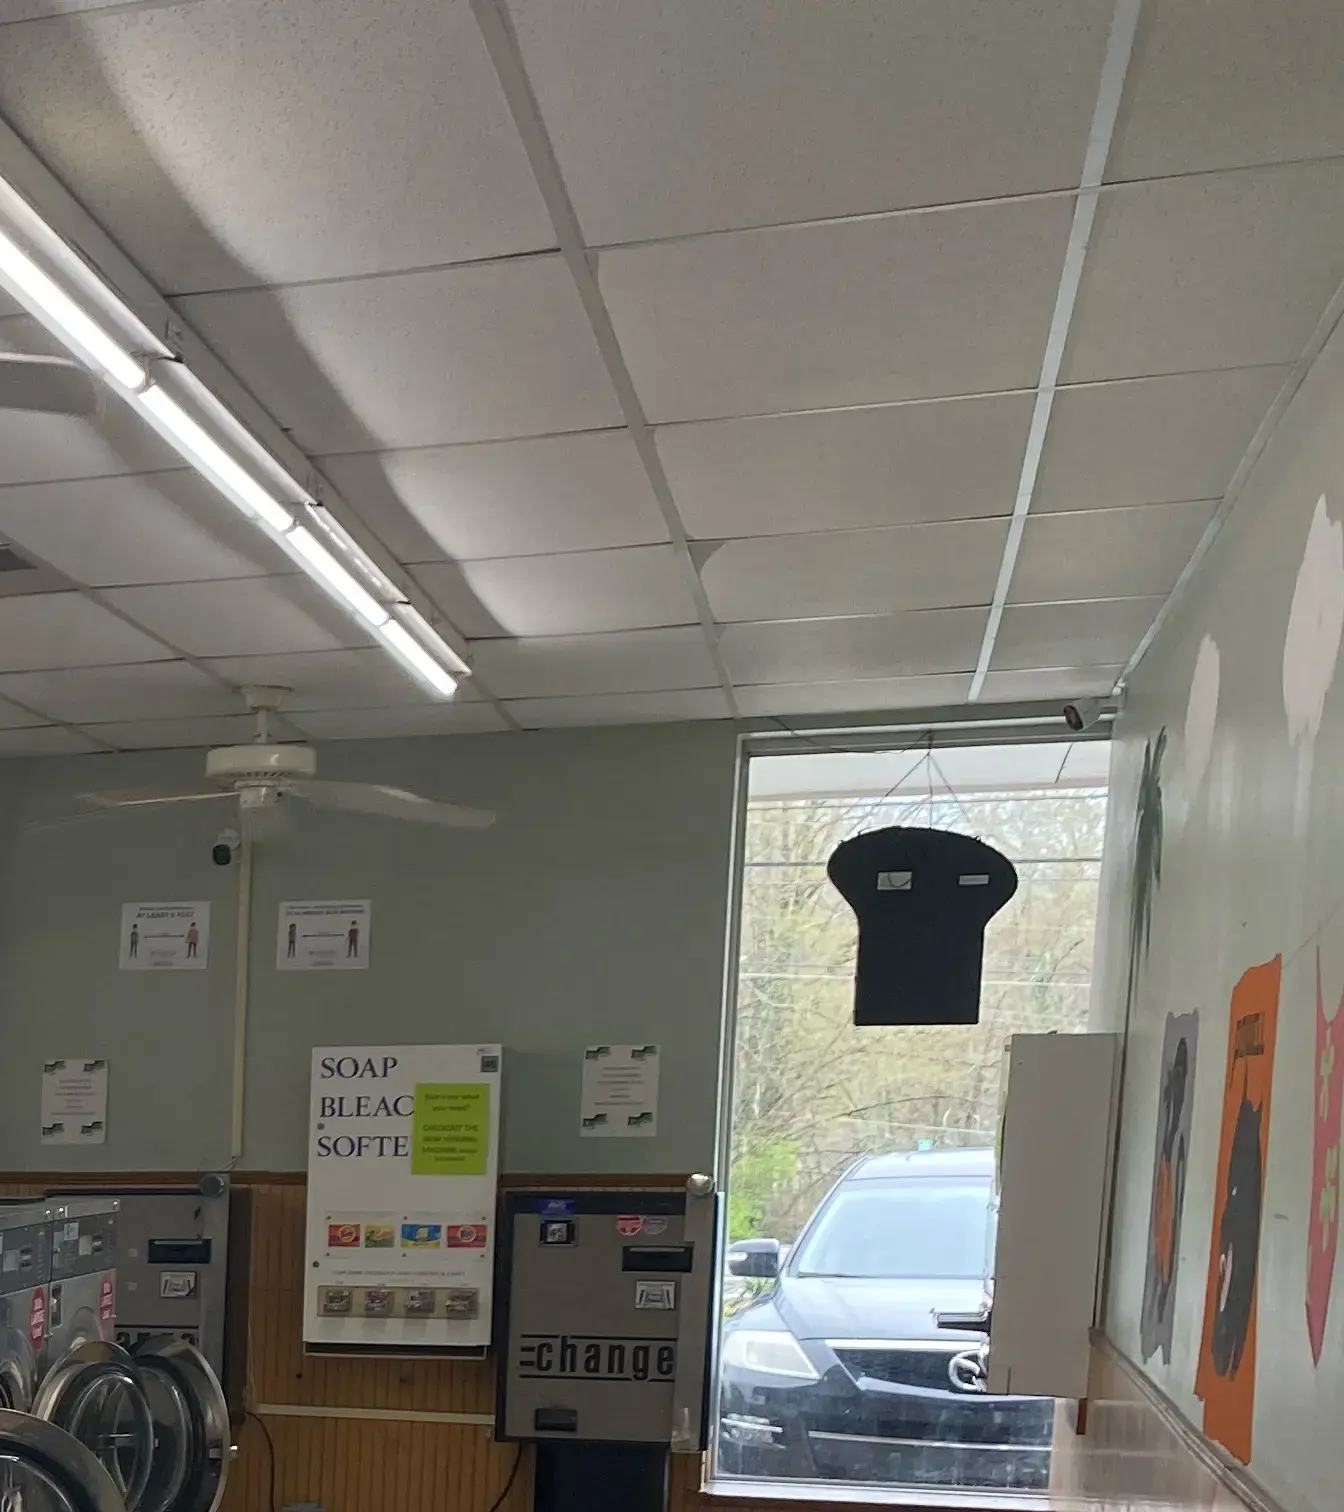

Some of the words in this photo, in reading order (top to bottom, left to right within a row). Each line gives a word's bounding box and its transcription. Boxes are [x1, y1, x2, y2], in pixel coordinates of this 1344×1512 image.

[320, 1056, 398, 1079] SOAP
[320, 1095, 414, 1117] BLEAC
[317, 1136, 409, 1158] SOFTE
[537, 1335, 675, 1381] change
